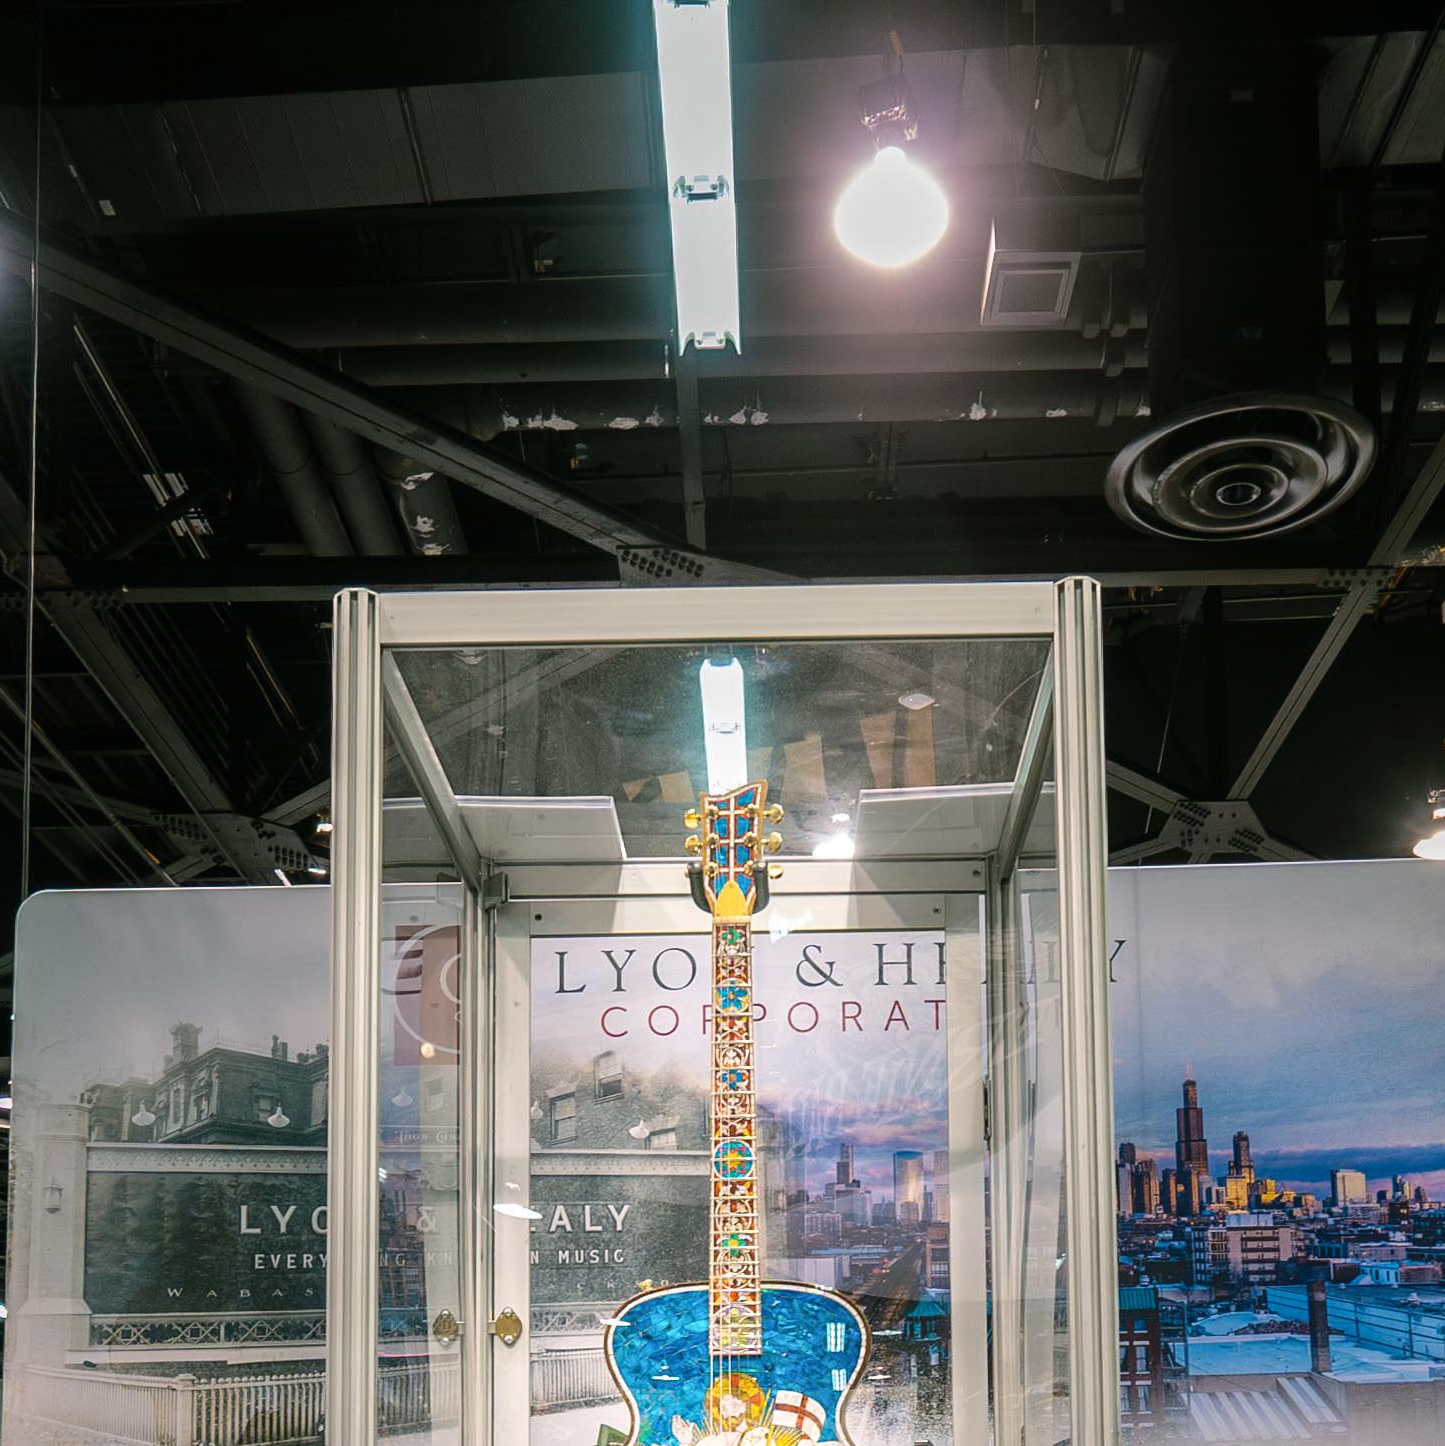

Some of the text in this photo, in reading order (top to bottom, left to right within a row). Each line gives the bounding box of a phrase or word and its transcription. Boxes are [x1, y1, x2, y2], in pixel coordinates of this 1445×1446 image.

[555, 946, 719, 995] LYO
[794, 943, 846, 987] &
[530, 1204, 632, 1233] ALY
[558, 1249, 625, 1265] MUSIC
[167, 1287, 314, 1298] WABAS
